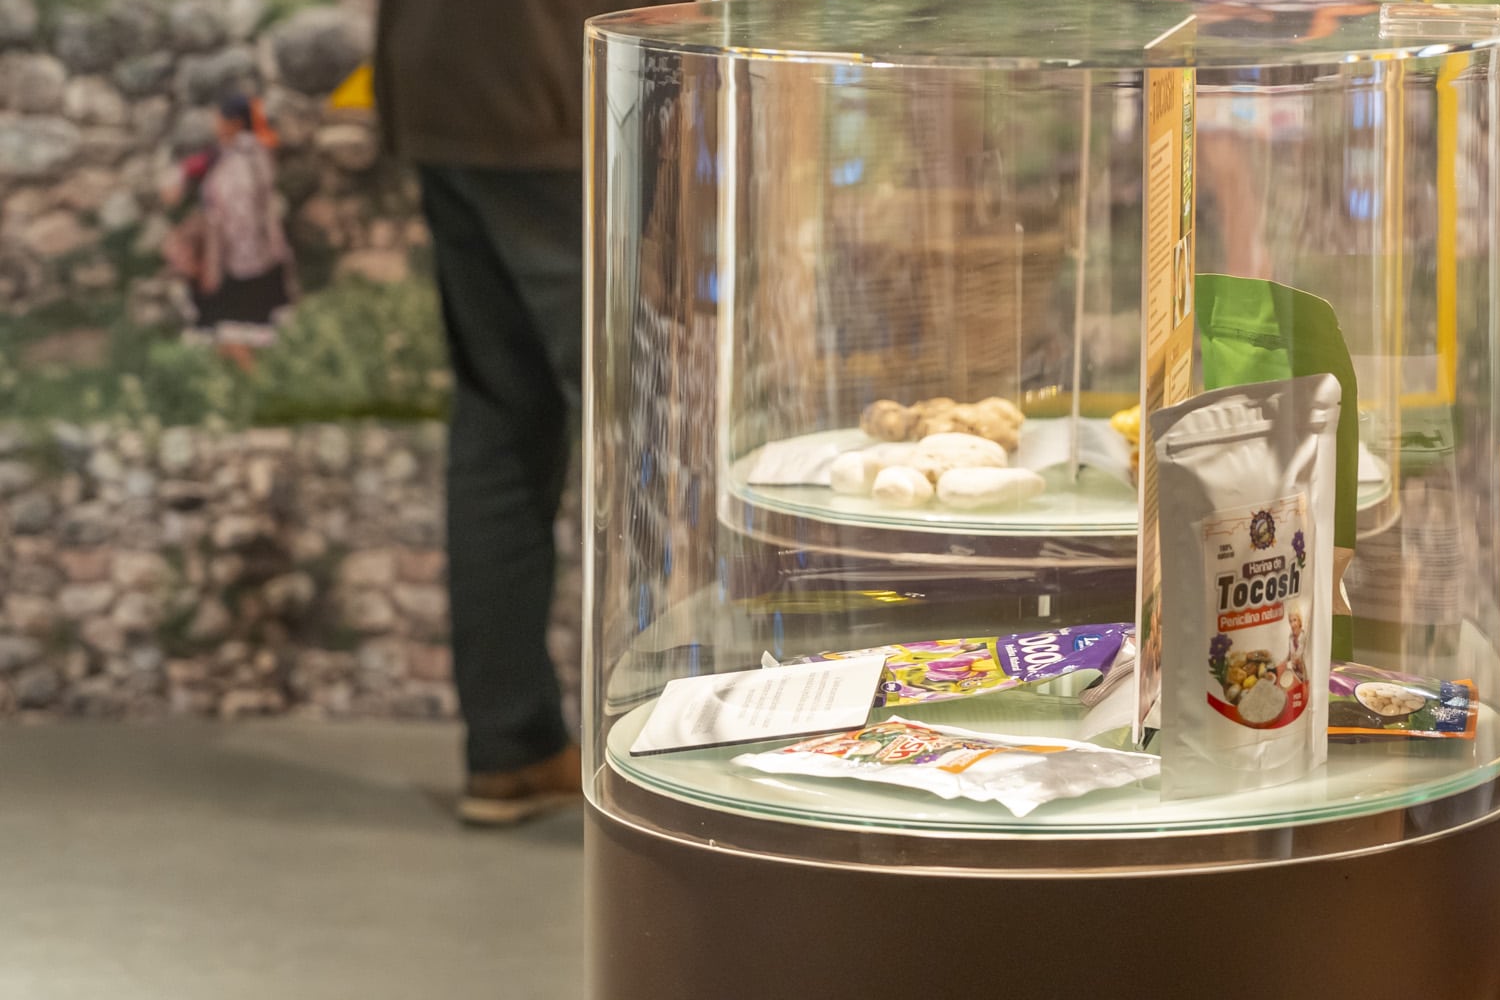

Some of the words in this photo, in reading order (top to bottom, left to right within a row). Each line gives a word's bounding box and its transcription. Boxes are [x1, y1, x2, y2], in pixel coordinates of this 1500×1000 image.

[1249, 560, 1272, 575] Harina
[1274, 559, 1282, 569] de
[1218, 562, 1300, 610] Tocosh
[1220, 612, 1260, 629] Penicilina
[1261, 606, 1284, 621] natural
